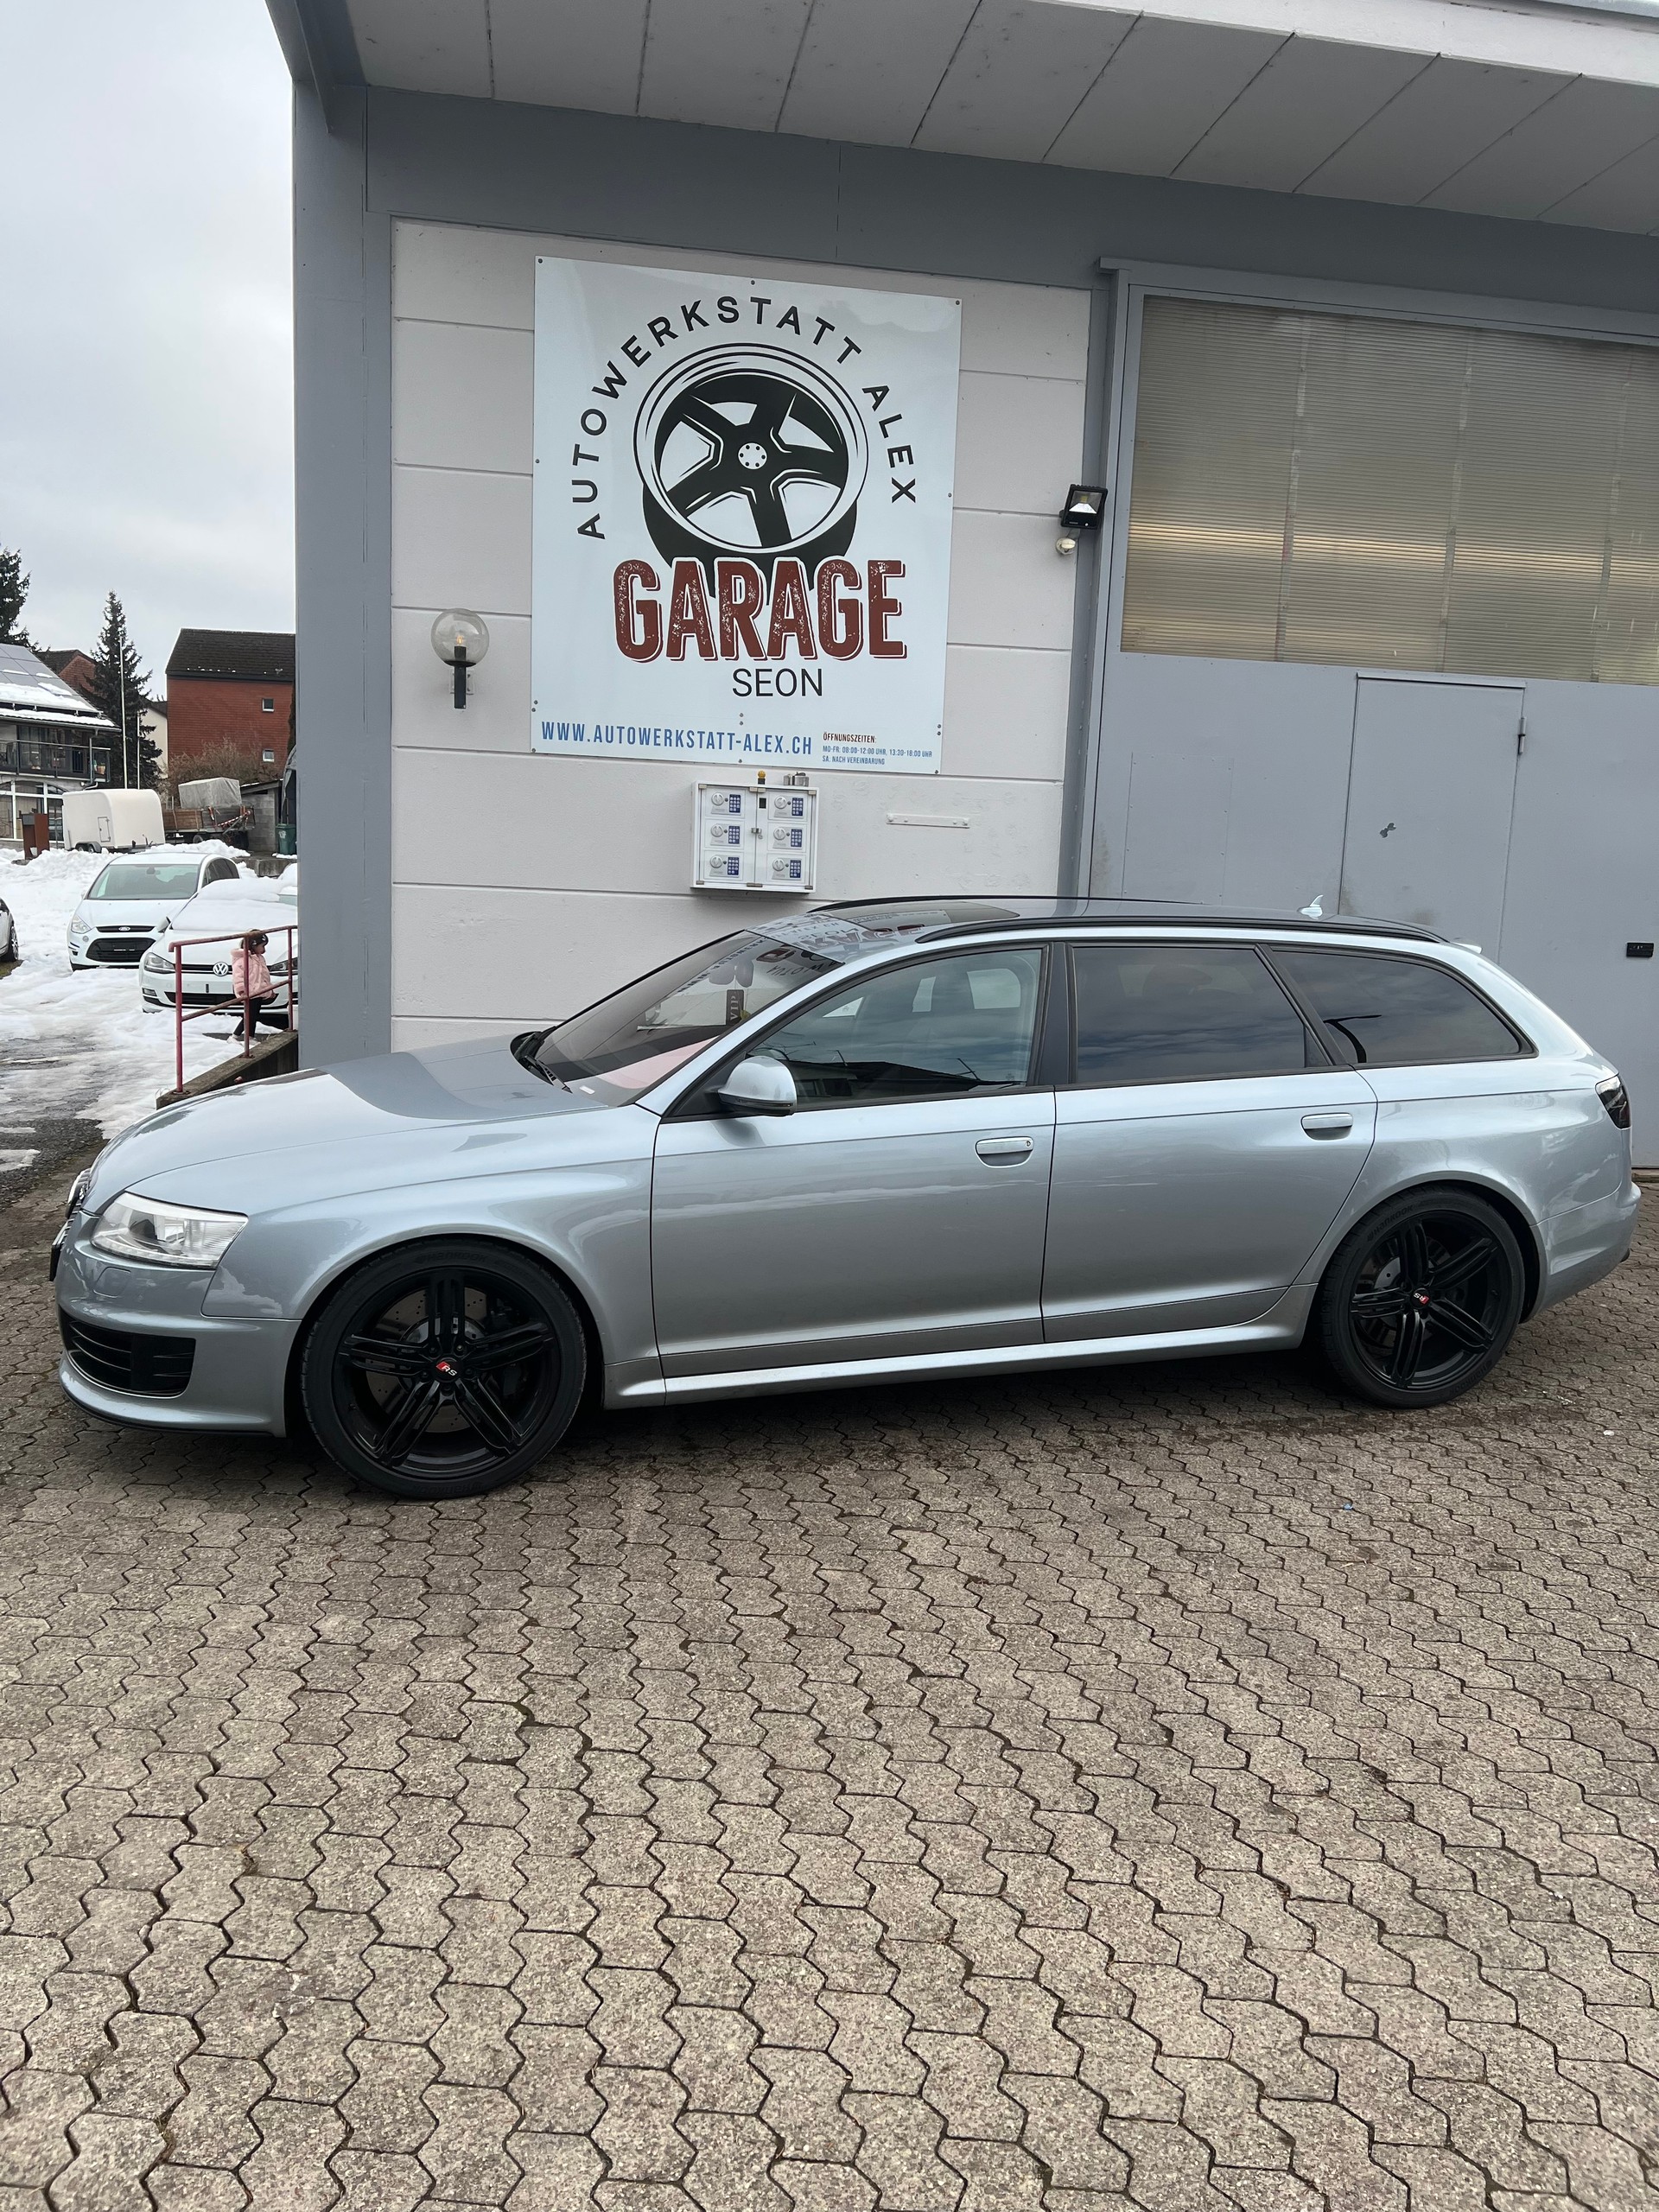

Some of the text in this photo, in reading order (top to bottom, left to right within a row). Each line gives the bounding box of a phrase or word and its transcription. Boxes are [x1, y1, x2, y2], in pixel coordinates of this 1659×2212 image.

[572, 296, 916, 539] AUTOWERKSTATT ALEX
[613, 557, 907, 663] GARAGE
[732, 668, 823, 697] SEON
[541, 721, 812, 755] WWW.AUTOWERKSTATT-ALEX.CH
[730, 995, 739, 1020] VIP
